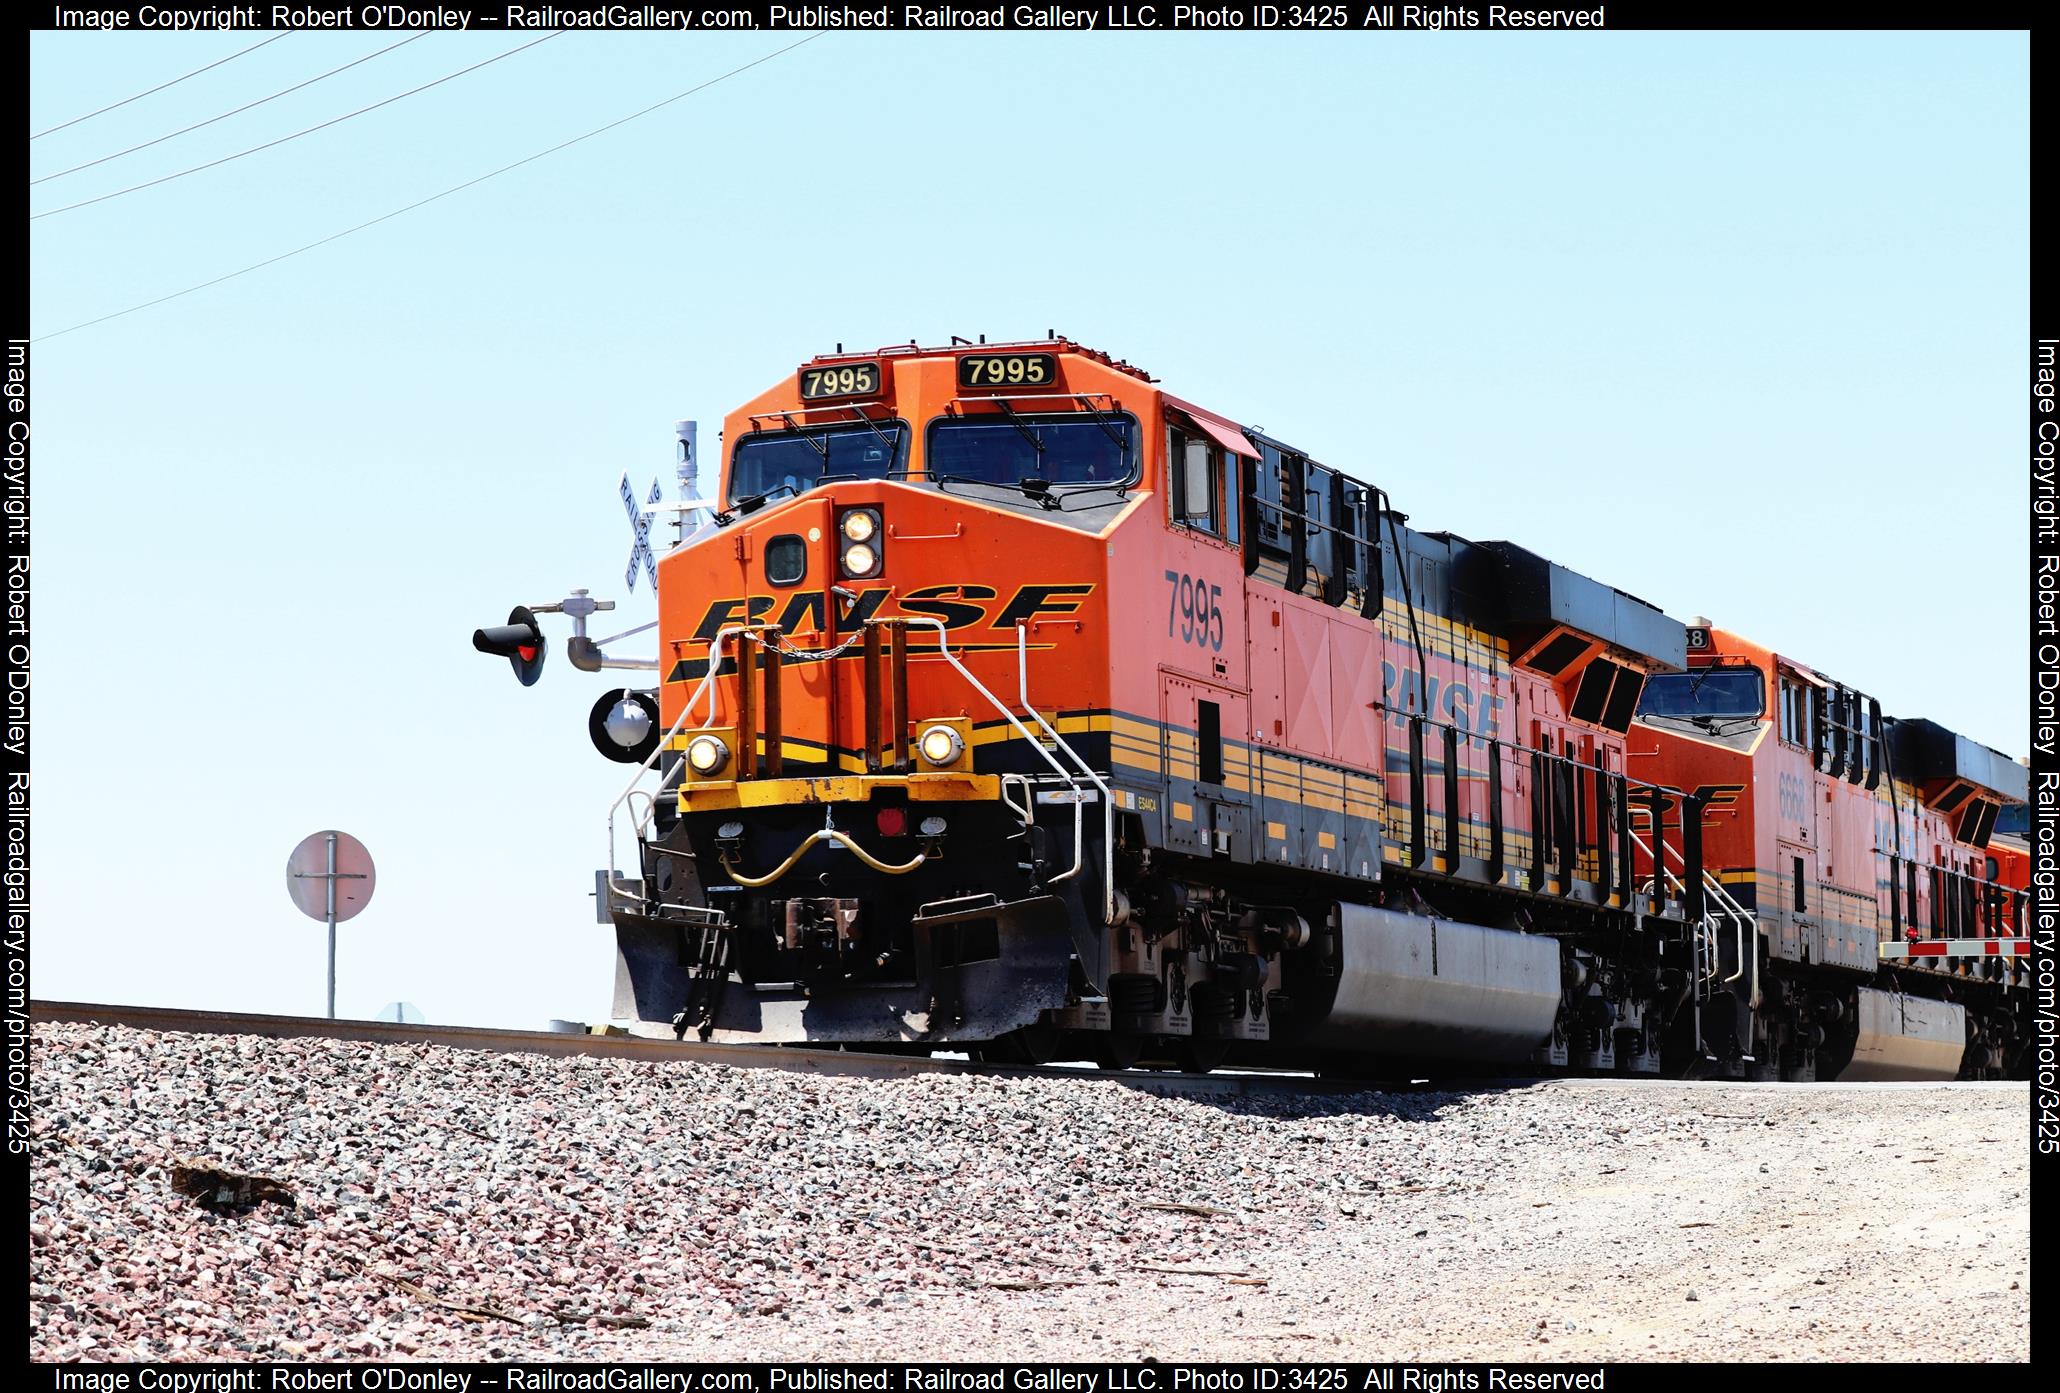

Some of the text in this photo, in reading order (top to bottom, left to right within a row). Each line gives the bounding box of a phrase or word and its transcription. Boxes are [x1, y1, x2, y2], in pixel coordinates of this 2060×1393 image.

[807, 366, 872, 396] 7995
[967, 358, 1045, 384] 7995
[689, 583, 1098, 647] BNSF
[1165, 569, 1223, 652] 7995
